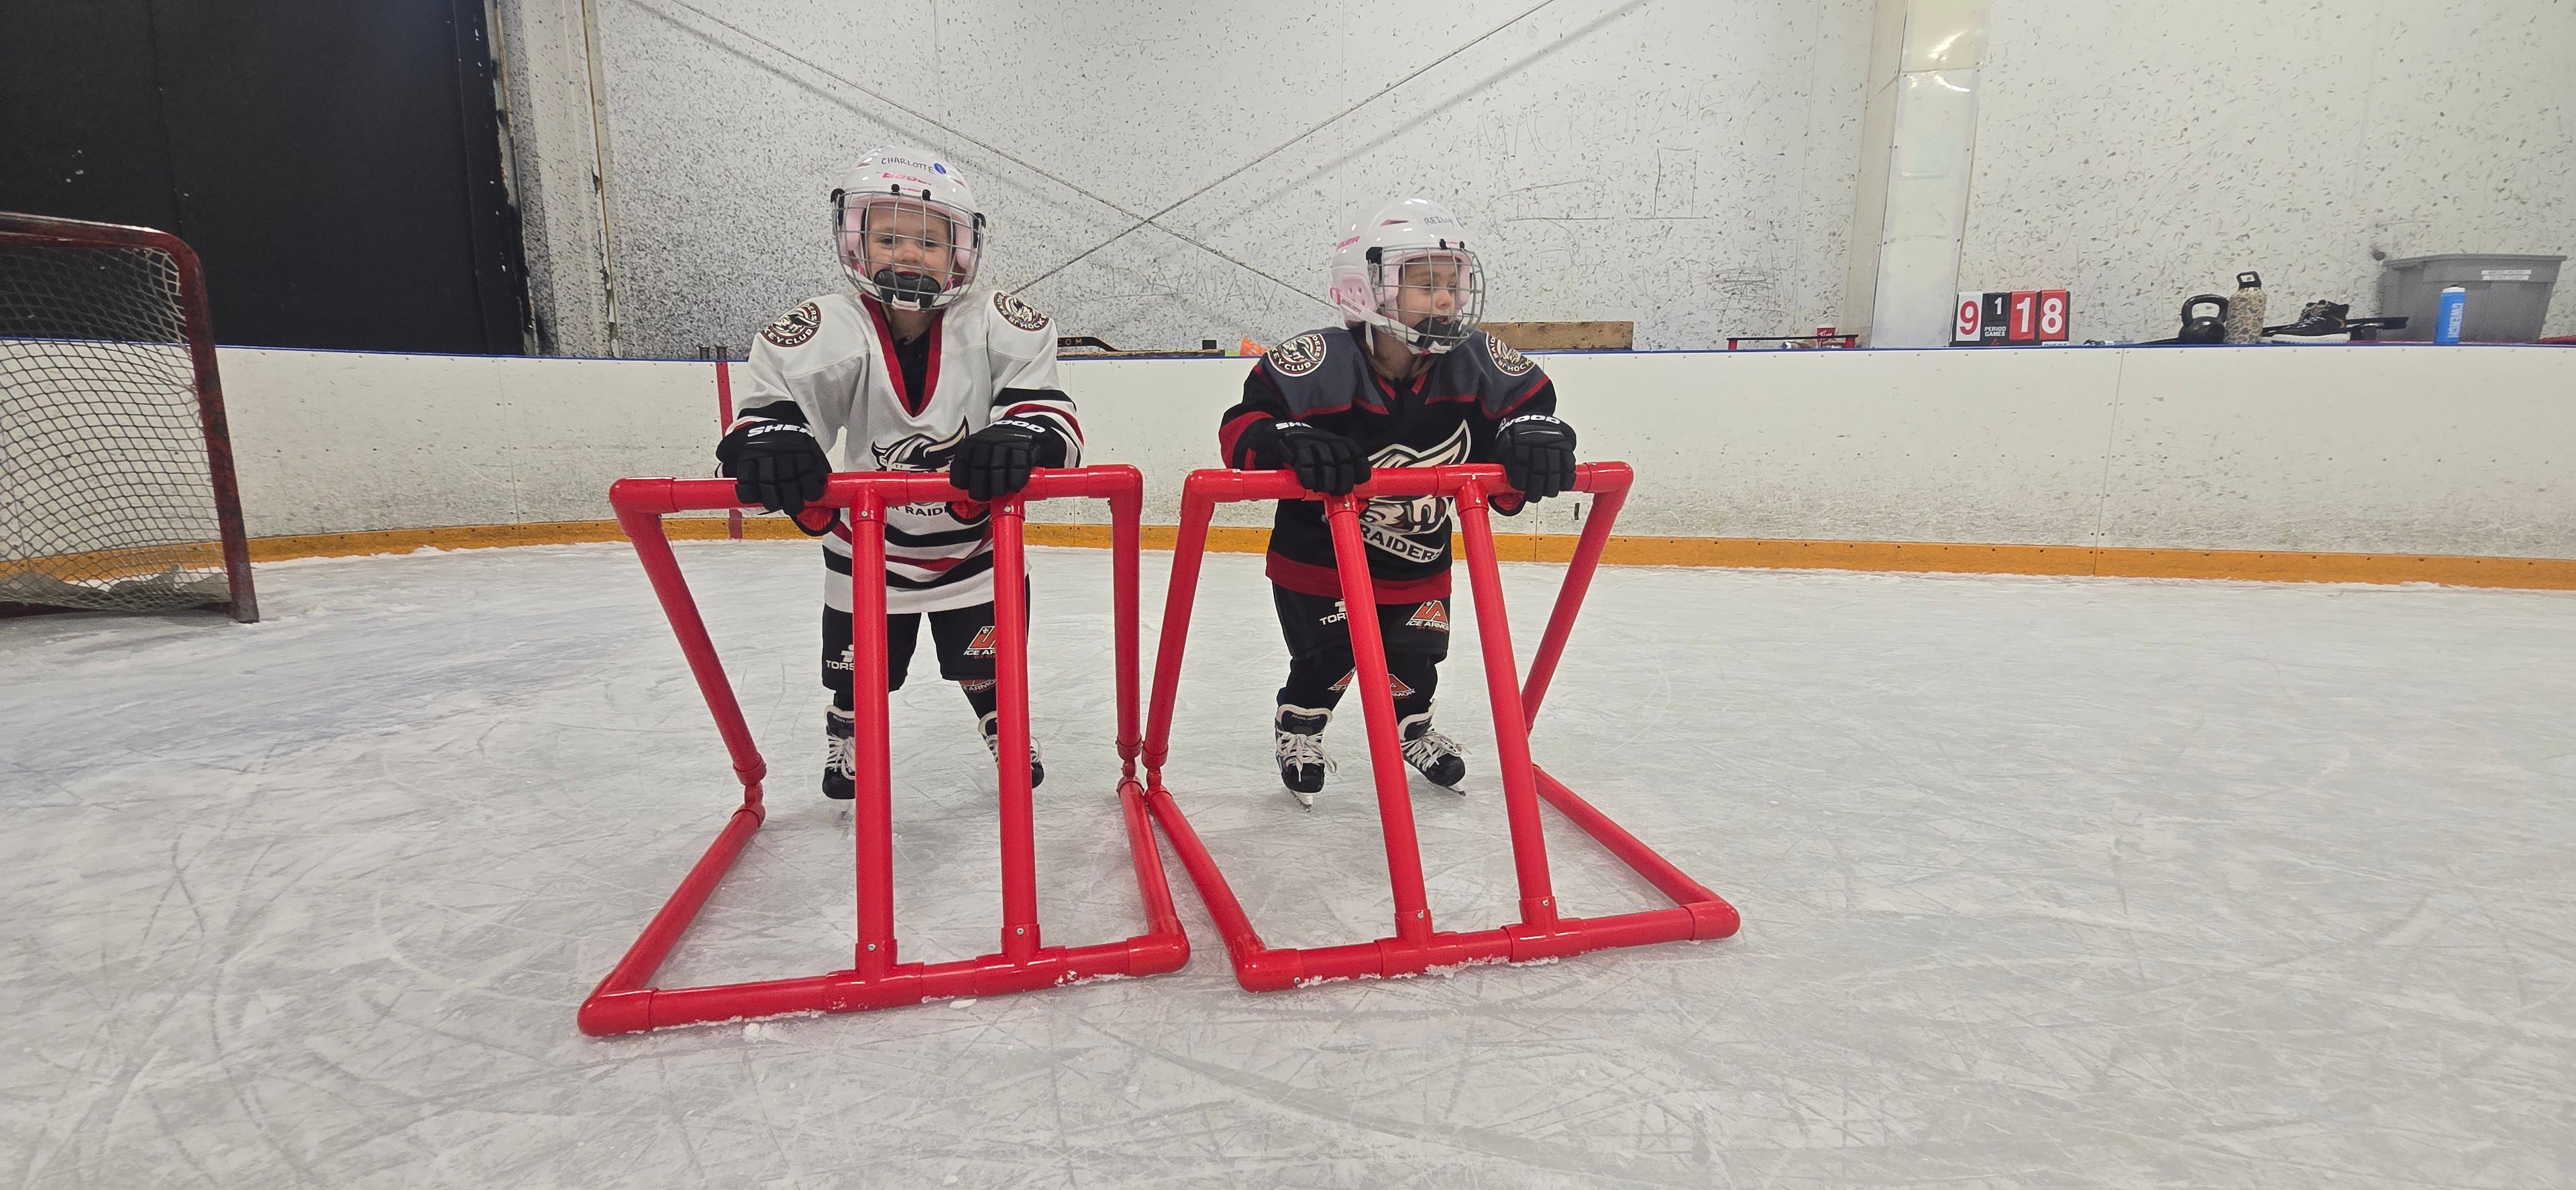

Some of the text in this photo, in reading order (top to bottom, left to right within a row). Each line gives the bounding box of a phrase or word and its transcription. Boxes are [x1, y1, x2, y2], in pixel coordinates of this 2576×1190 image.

[881, 157, 934, 174] CHARLOTTE
[1960, 301, 1979, 335] 9
[1994, 297, 2002, 315] 1
[785, 328, 814, 344] CLUB
[1284, 362, 1312, 372] CLUB
[905, 505, 947, 517] RAID
